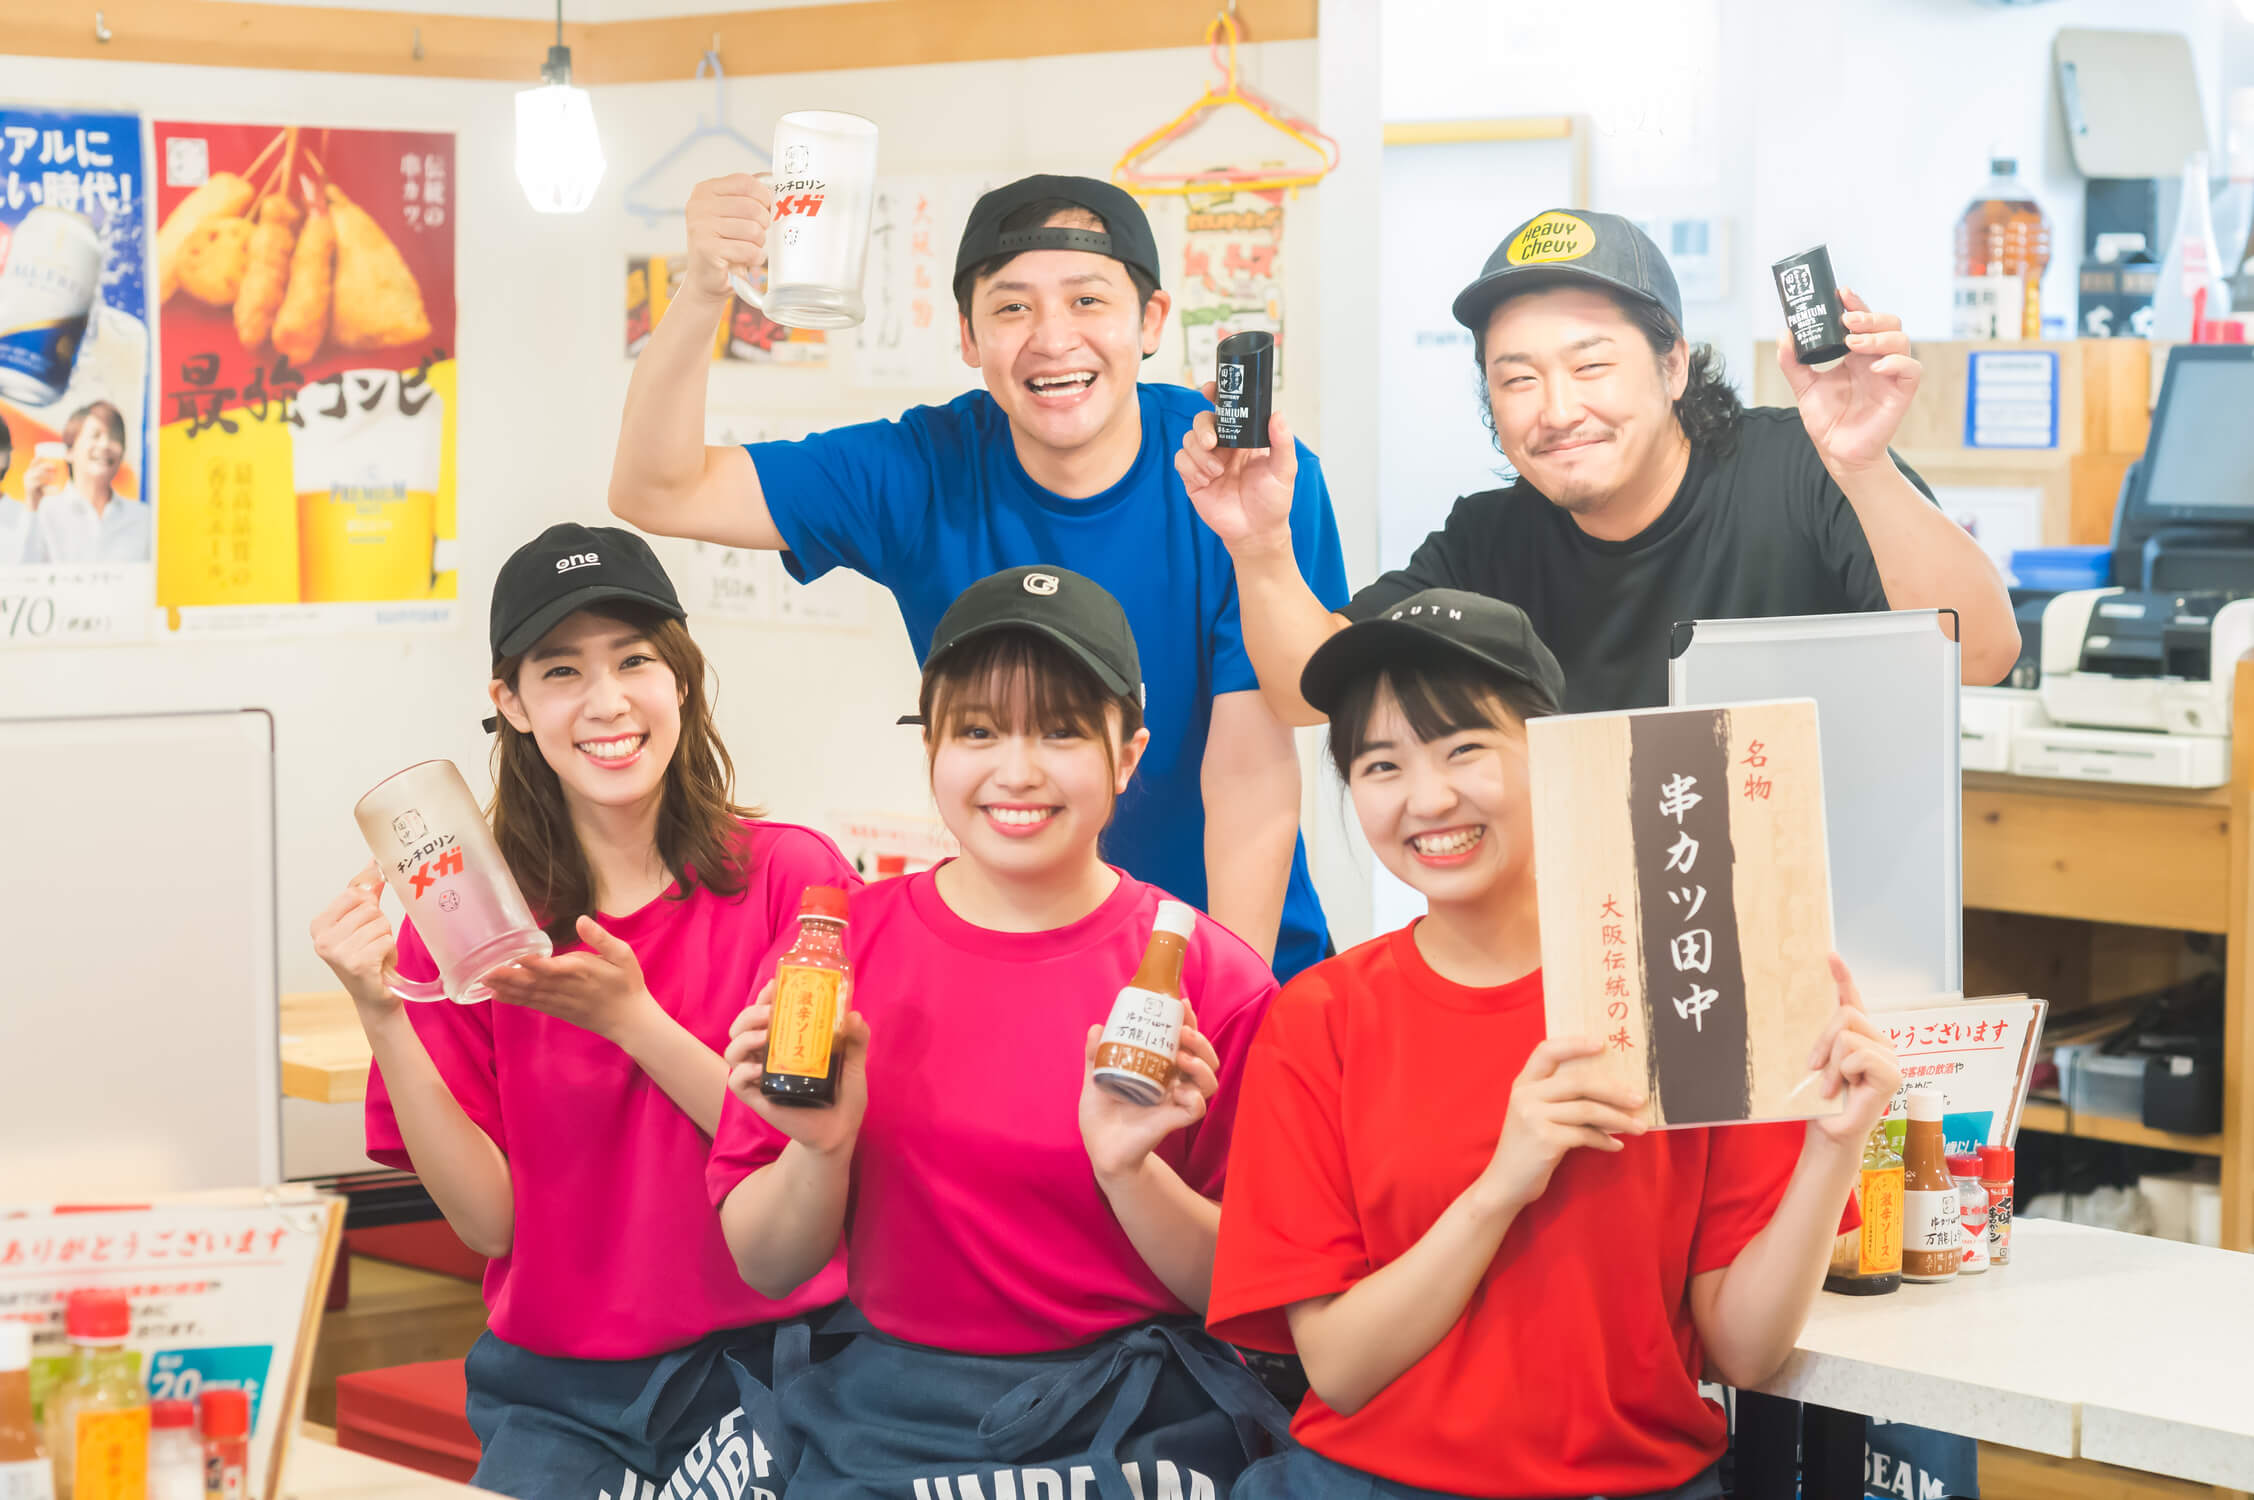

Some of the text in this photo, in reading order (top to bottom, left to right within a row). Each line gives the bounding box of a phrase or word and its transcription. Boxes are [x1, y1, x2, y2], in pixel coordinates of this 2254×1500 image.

[0, 126, 113, 168] アルに
[0, 171, 132, 215] い時代!
[773, 194, 825, 221] メガ
[168, 348, 446, 439] 最強コンビ
[556, 552, 599, 570] one
[1023, 573, 1059, 596] G
[1740, 740, 1773, 802] 名物
[397, 834, 455, 874] チンチロリン
[408, 845, 464, 900] メガ
[1657, 773, 1720, 1033] 串カツ田中
[1600, 893, 1635, 1053] 大阪伝統の味
[151, 1369, 202, 1400] 20
